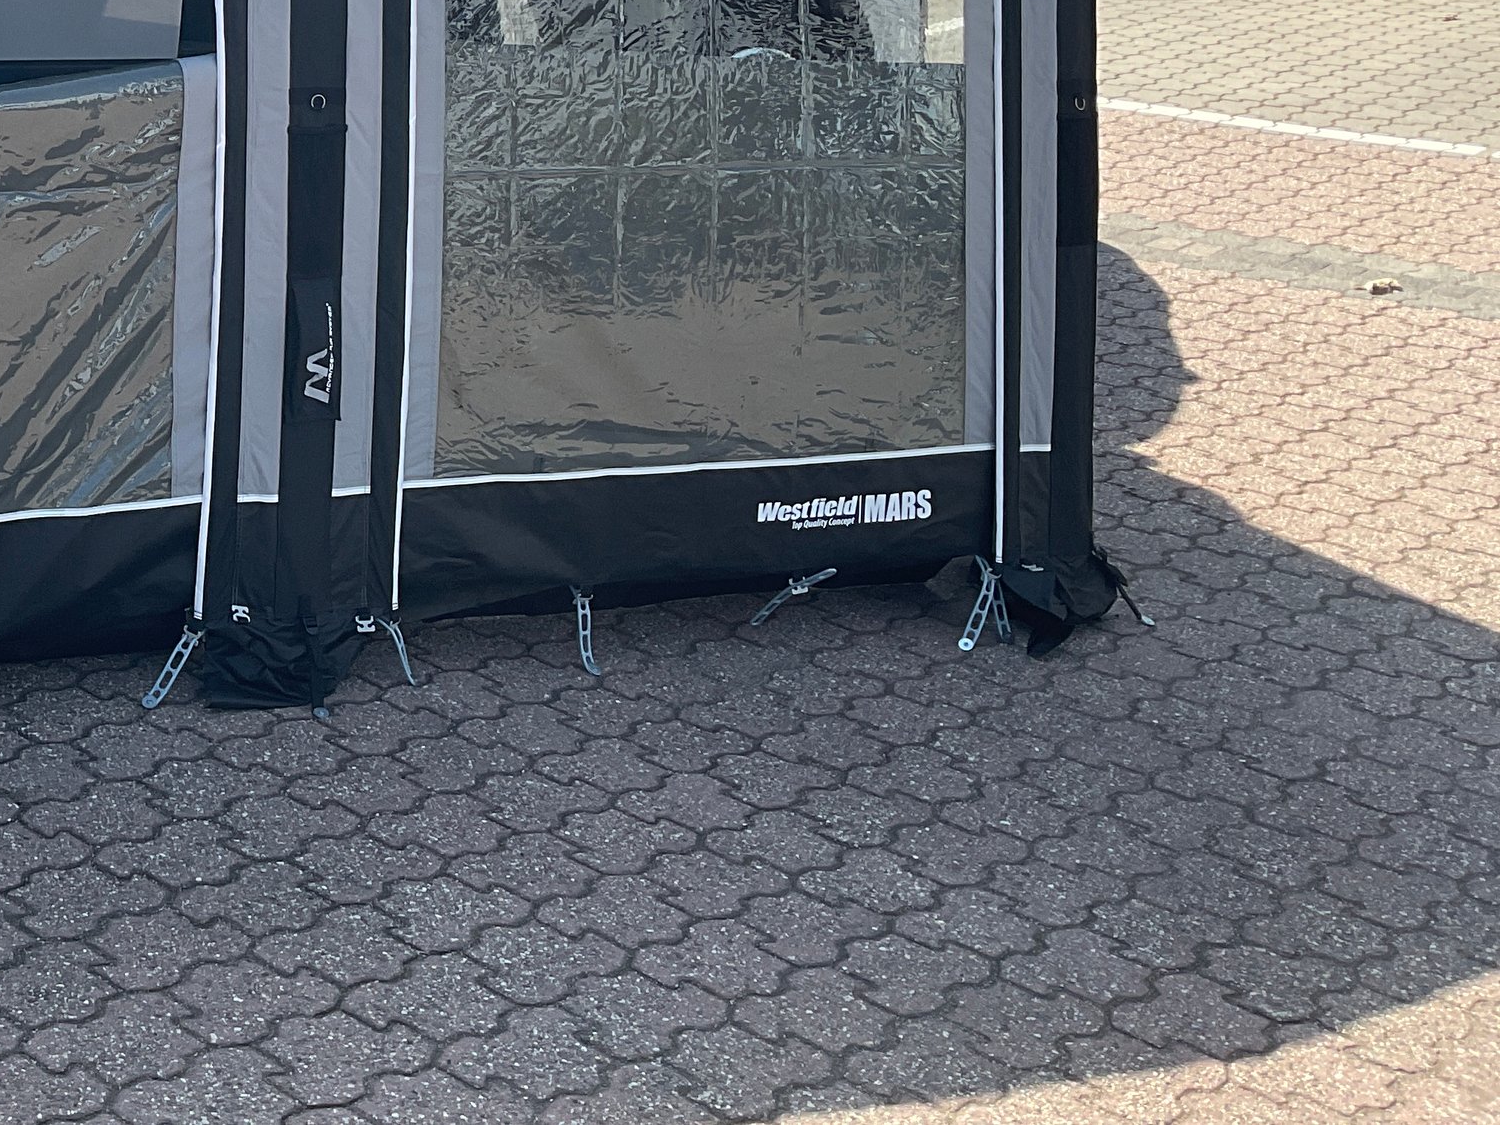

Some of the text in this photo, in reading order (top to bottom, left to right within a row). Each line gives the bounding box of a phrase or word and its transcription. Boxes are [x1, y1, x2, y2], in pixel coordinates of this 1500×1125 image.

[757, 489, 932, 524] Westfield MARS
[791, 516, 855, 530] Top Quality Concept
